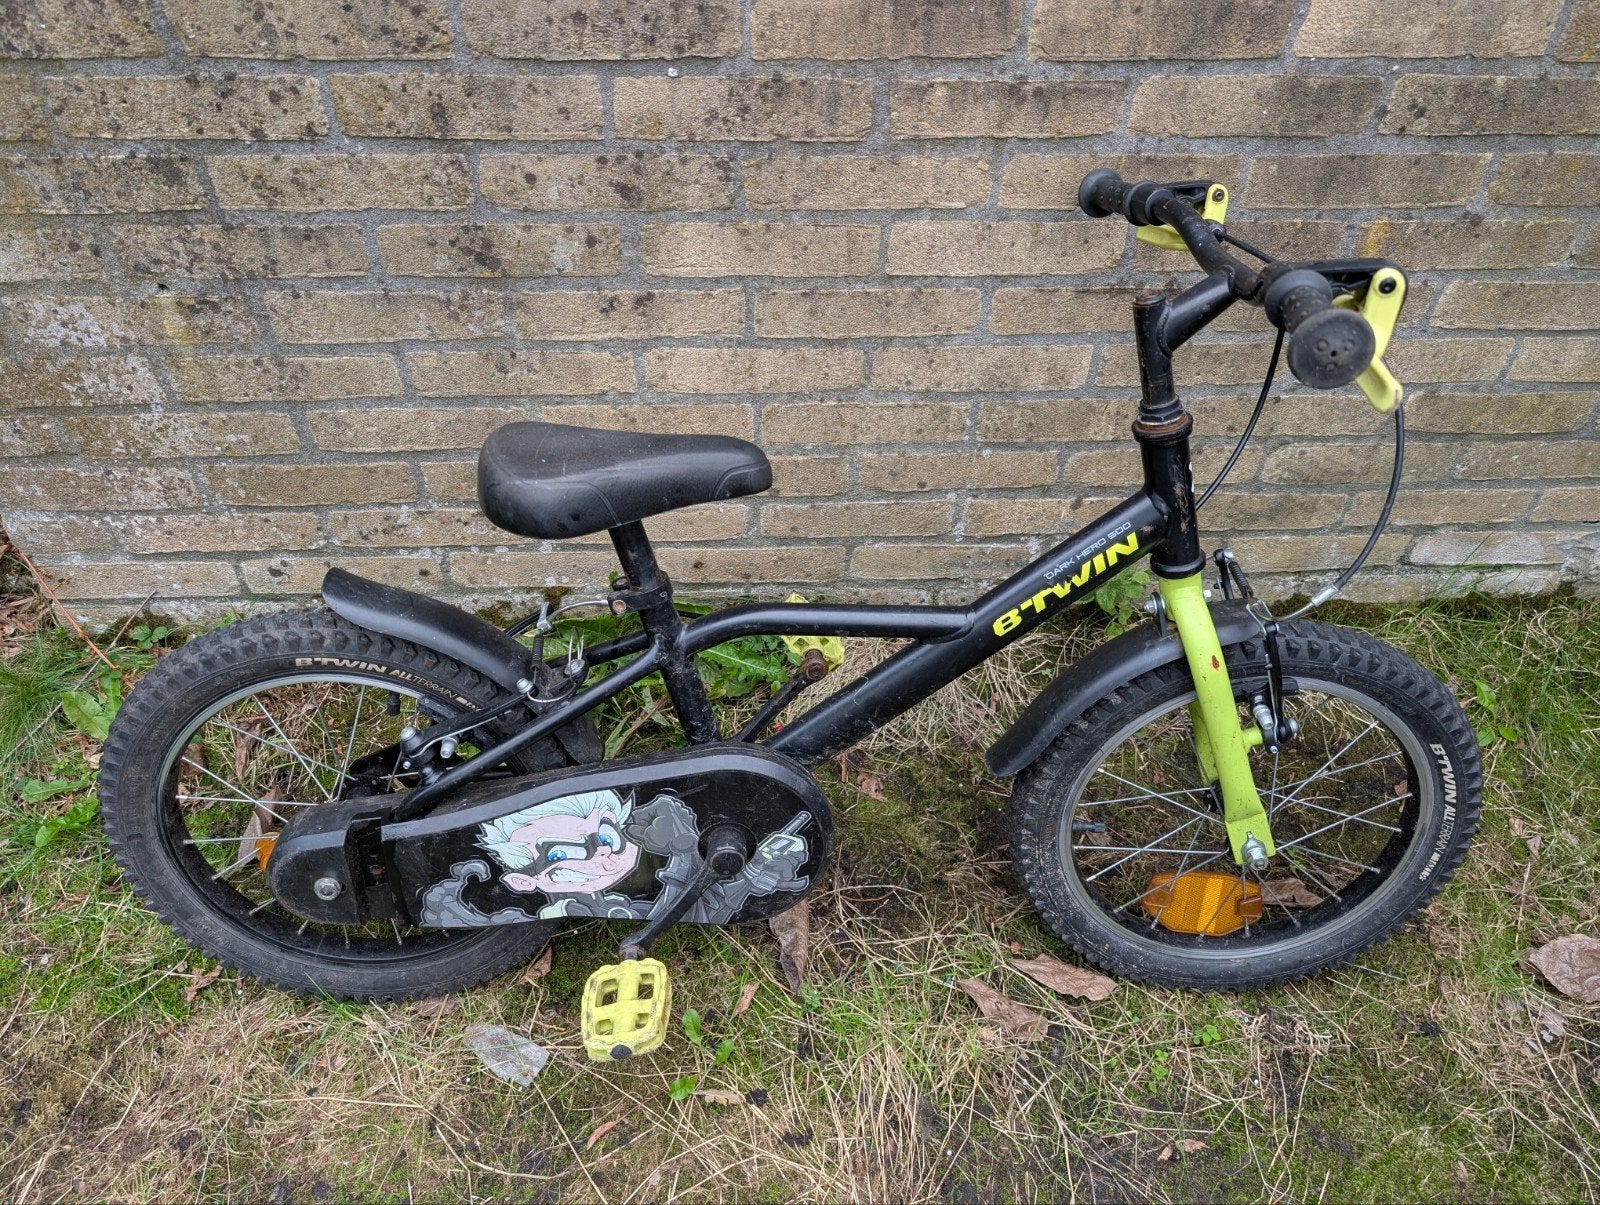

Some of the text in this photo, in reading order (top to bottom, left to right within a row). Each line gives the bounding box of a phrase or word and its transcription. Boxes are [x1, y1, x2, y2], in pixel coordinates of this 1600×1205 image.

[1043, 521, 1132, 580] DARK HERO 500
